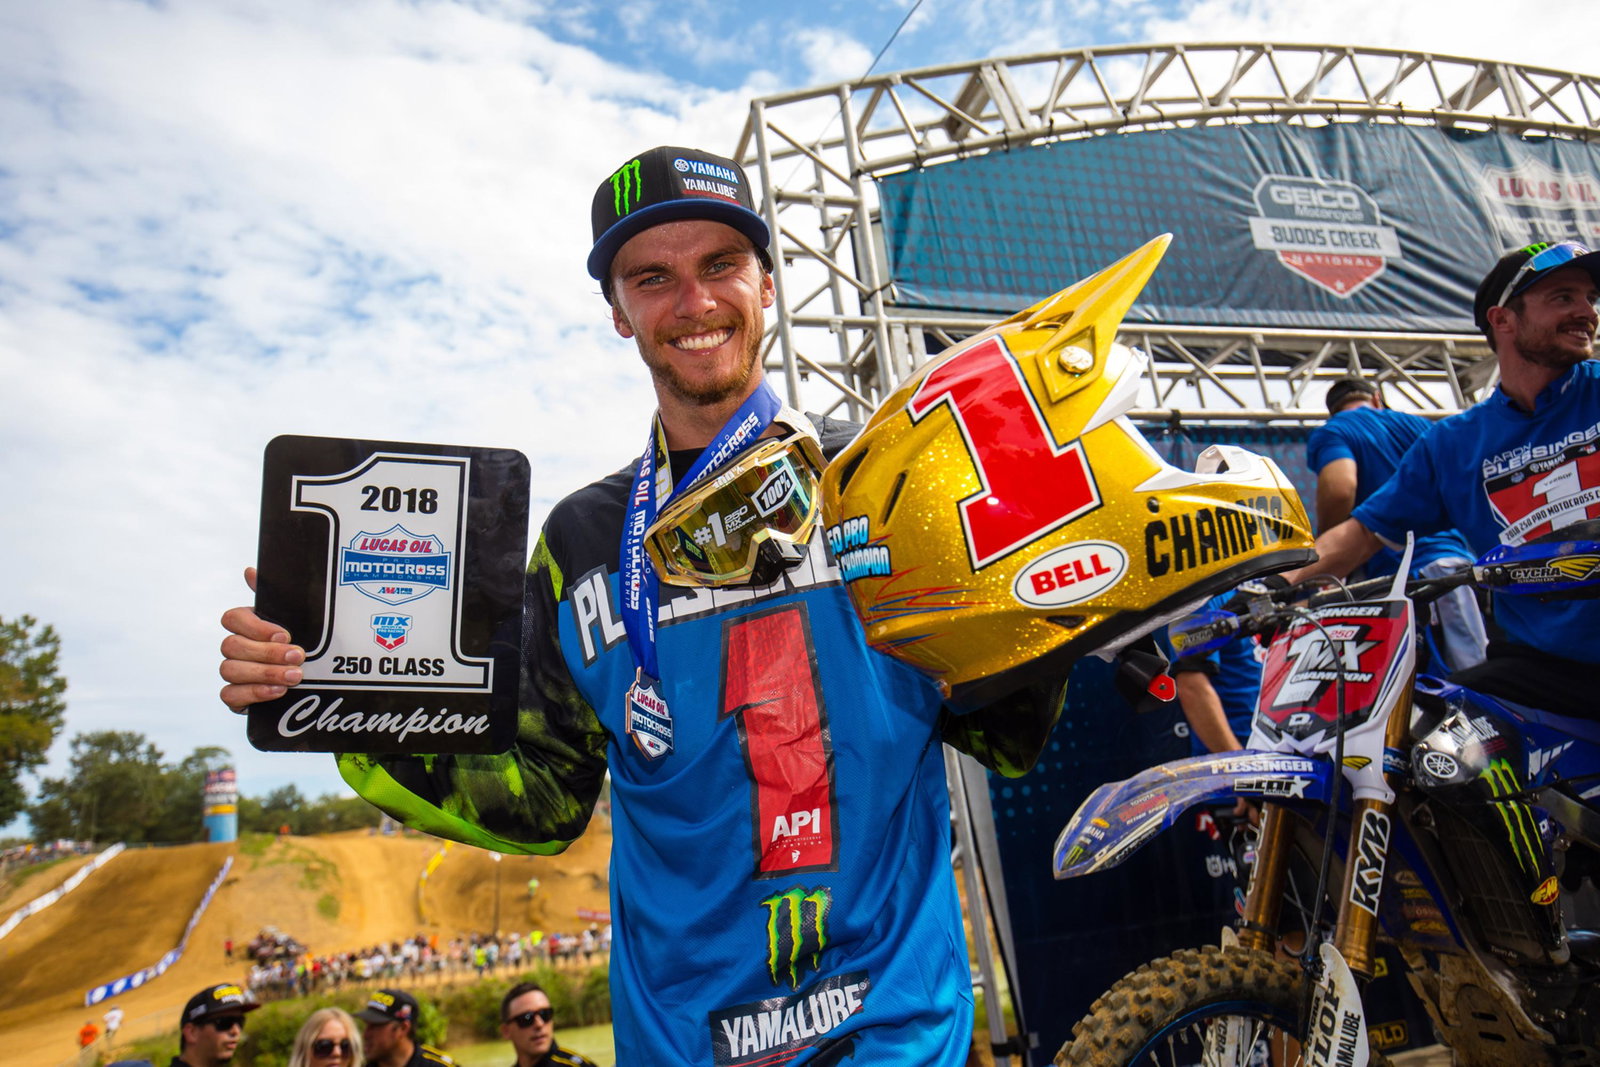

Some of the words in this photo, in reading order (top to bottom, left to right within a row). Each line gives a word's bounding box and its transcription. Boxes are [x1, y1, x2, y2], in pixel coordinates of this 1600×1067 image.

[689, 160, 739, 184] YAMAHA
[682, 178, 737, 200] YAMALUBE
[1270, 185, 1360, 210] GEICO
[1498, 177, 1561, 201] LUCAS
[1271, 225, 1327, 248] BUDDS
[1329, 228, 1382, 249] CREEK
[1291, 253, 1376, 268] NATIONAL
[906, 334, 1102, 573] 1
[1482, 421, 1600, 479] PLESSINGE
[1482, 441, 1532, 466] AARON
[360, 485, 439, 514] 2018
[634, 480, 650, 507] OIL
[761, 471, 791, 510] 100%
[724, 505, 748, 523] 250
[725, 517, 742, 530] MX
[726, 514, 757, 535] CHAMPION
[1505, 526, 1521, 541] 2018
[1520, 518, 1533, 530] 250
[1532, 510, 1548, 524] PRO
[1547, 491, 1595, 516] MOTOCROSS
[693, 512, 727, 547] #1
[843, 516, 870, 549] PRO
[360, 538, 408, 553] LUCAS
[409, 540, 433, 553] OIL
[344, 572, 446, 581] CHAMPIONSHIP
[345, 561, 446, 576] MOTOCROSS
[840, 546, 892, 583] CHAMPION
[1030, 553, 1111, 596] BELL
[1511, 567, 1562, 580] CYCRA
[1329, 629, 1355, 639] 250
[332, 656, 372, 675] 250
[379, 656, 445, 676] CLASS
[1300, 639, 1381, 674] MX
[636, 691, 655, 711] LUCAS
[655, 702, 666, 715] OIL
[277, 694, 490, 743] Champion
[632, 710, 672, 738] MOTOCROSS
[771, 808, 821, 842] AP1
[1350, 808, 1391, 916] KYB
[721, 987, 864, 1059] YAMALUBE
[1334, 1010, 1361, 1067] AMALUBE
